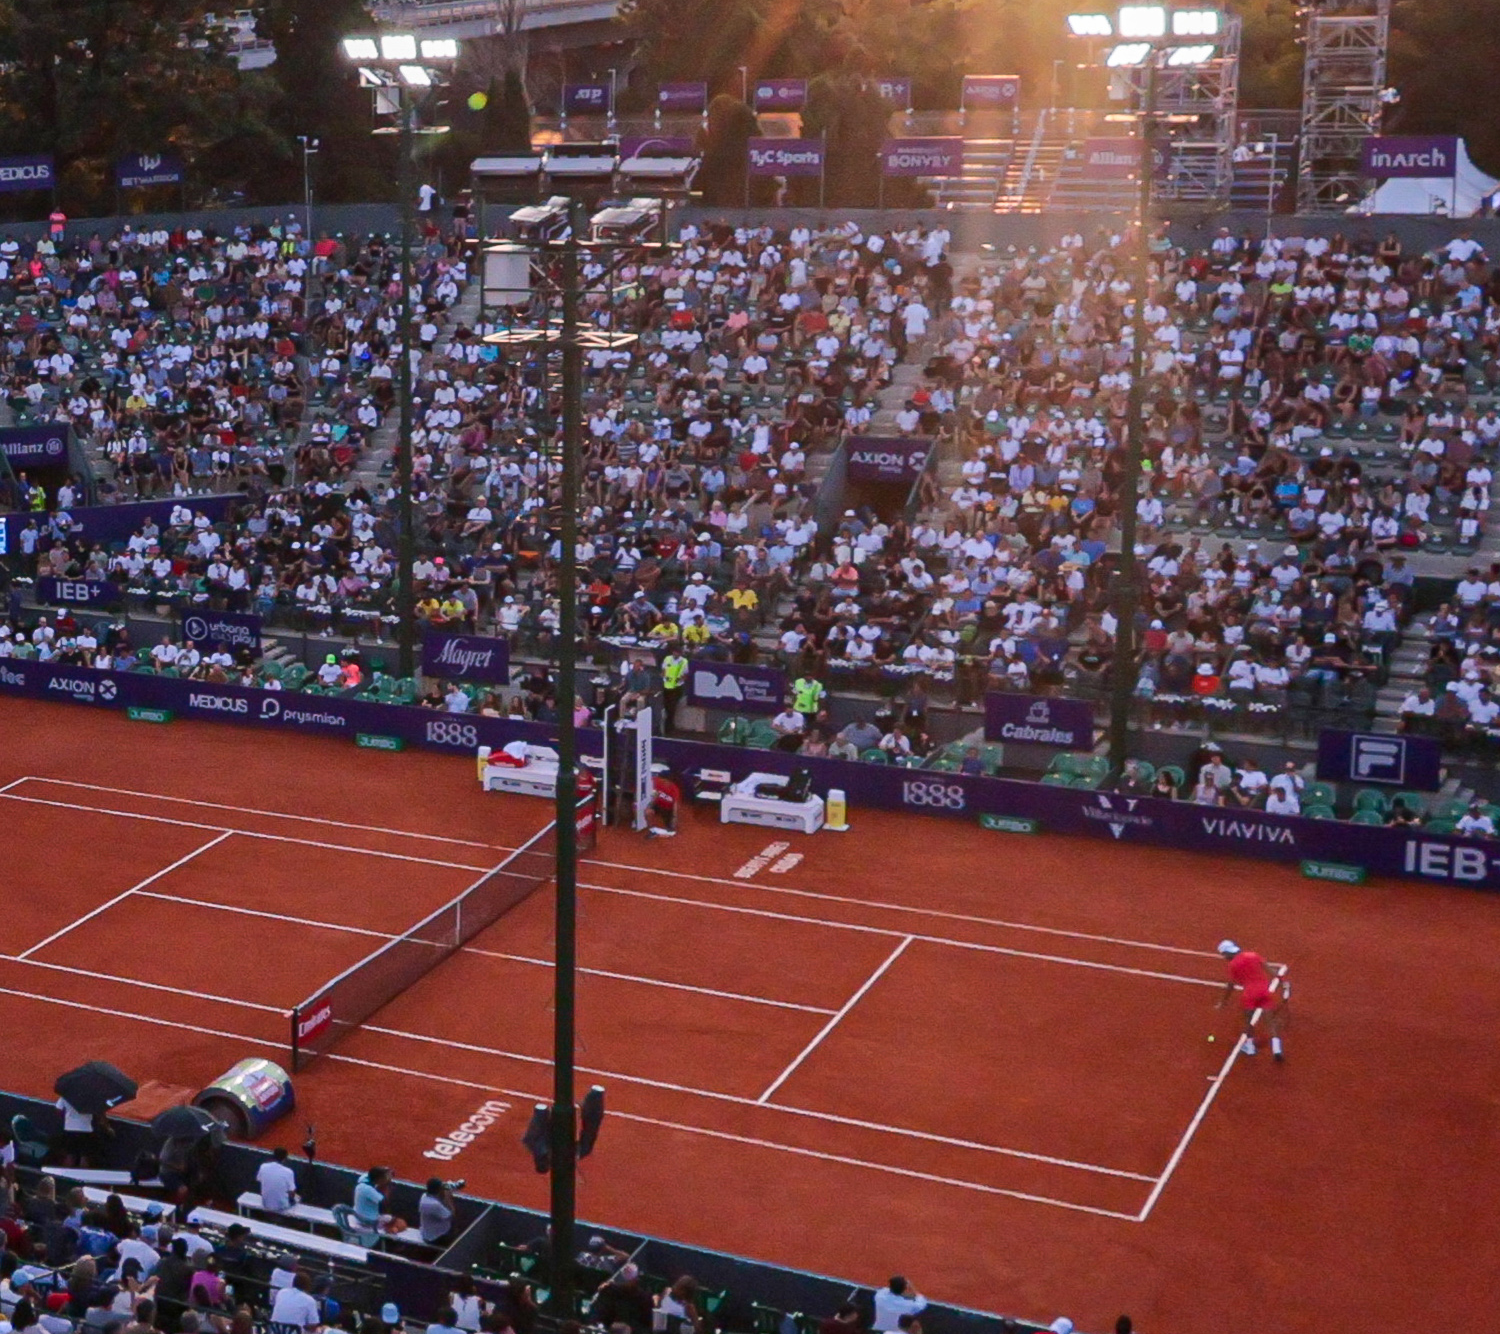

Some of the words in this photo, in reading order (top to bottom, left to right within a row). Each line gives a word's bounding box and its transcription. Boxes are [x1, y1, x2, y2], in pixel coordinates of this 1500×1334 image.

[750, 148, 775, 166] TyC
[776, 148, 820, 165] Sports
[888, 154, 953, 168] BONVOY
[1089, 151, 1142, 166] Allian
[850, 451, 904, 466] AXION
[56, 581, 101, 601] IEB+
[209, 621, 250, 635] urbana
[232, 632, 257, 648] play
[432, 637, 495, 675] Magret
[48, 677, 95, 695] AXION
[693, 671, 744, 702] BA
[189, 694, 249, 714] MEDICUS
[283, 708, 346, 727] prysmian
[359, 735, 397, 750] JUMBO
[426, 720, 478, 748] 1888
[1001, 722, 1074, 745] Cabrales
[903, 781, 965, 810] 1888
[1202, 817, 1295, 845] VIAVIVA
[423, 1098, 513, 1162] telecom
